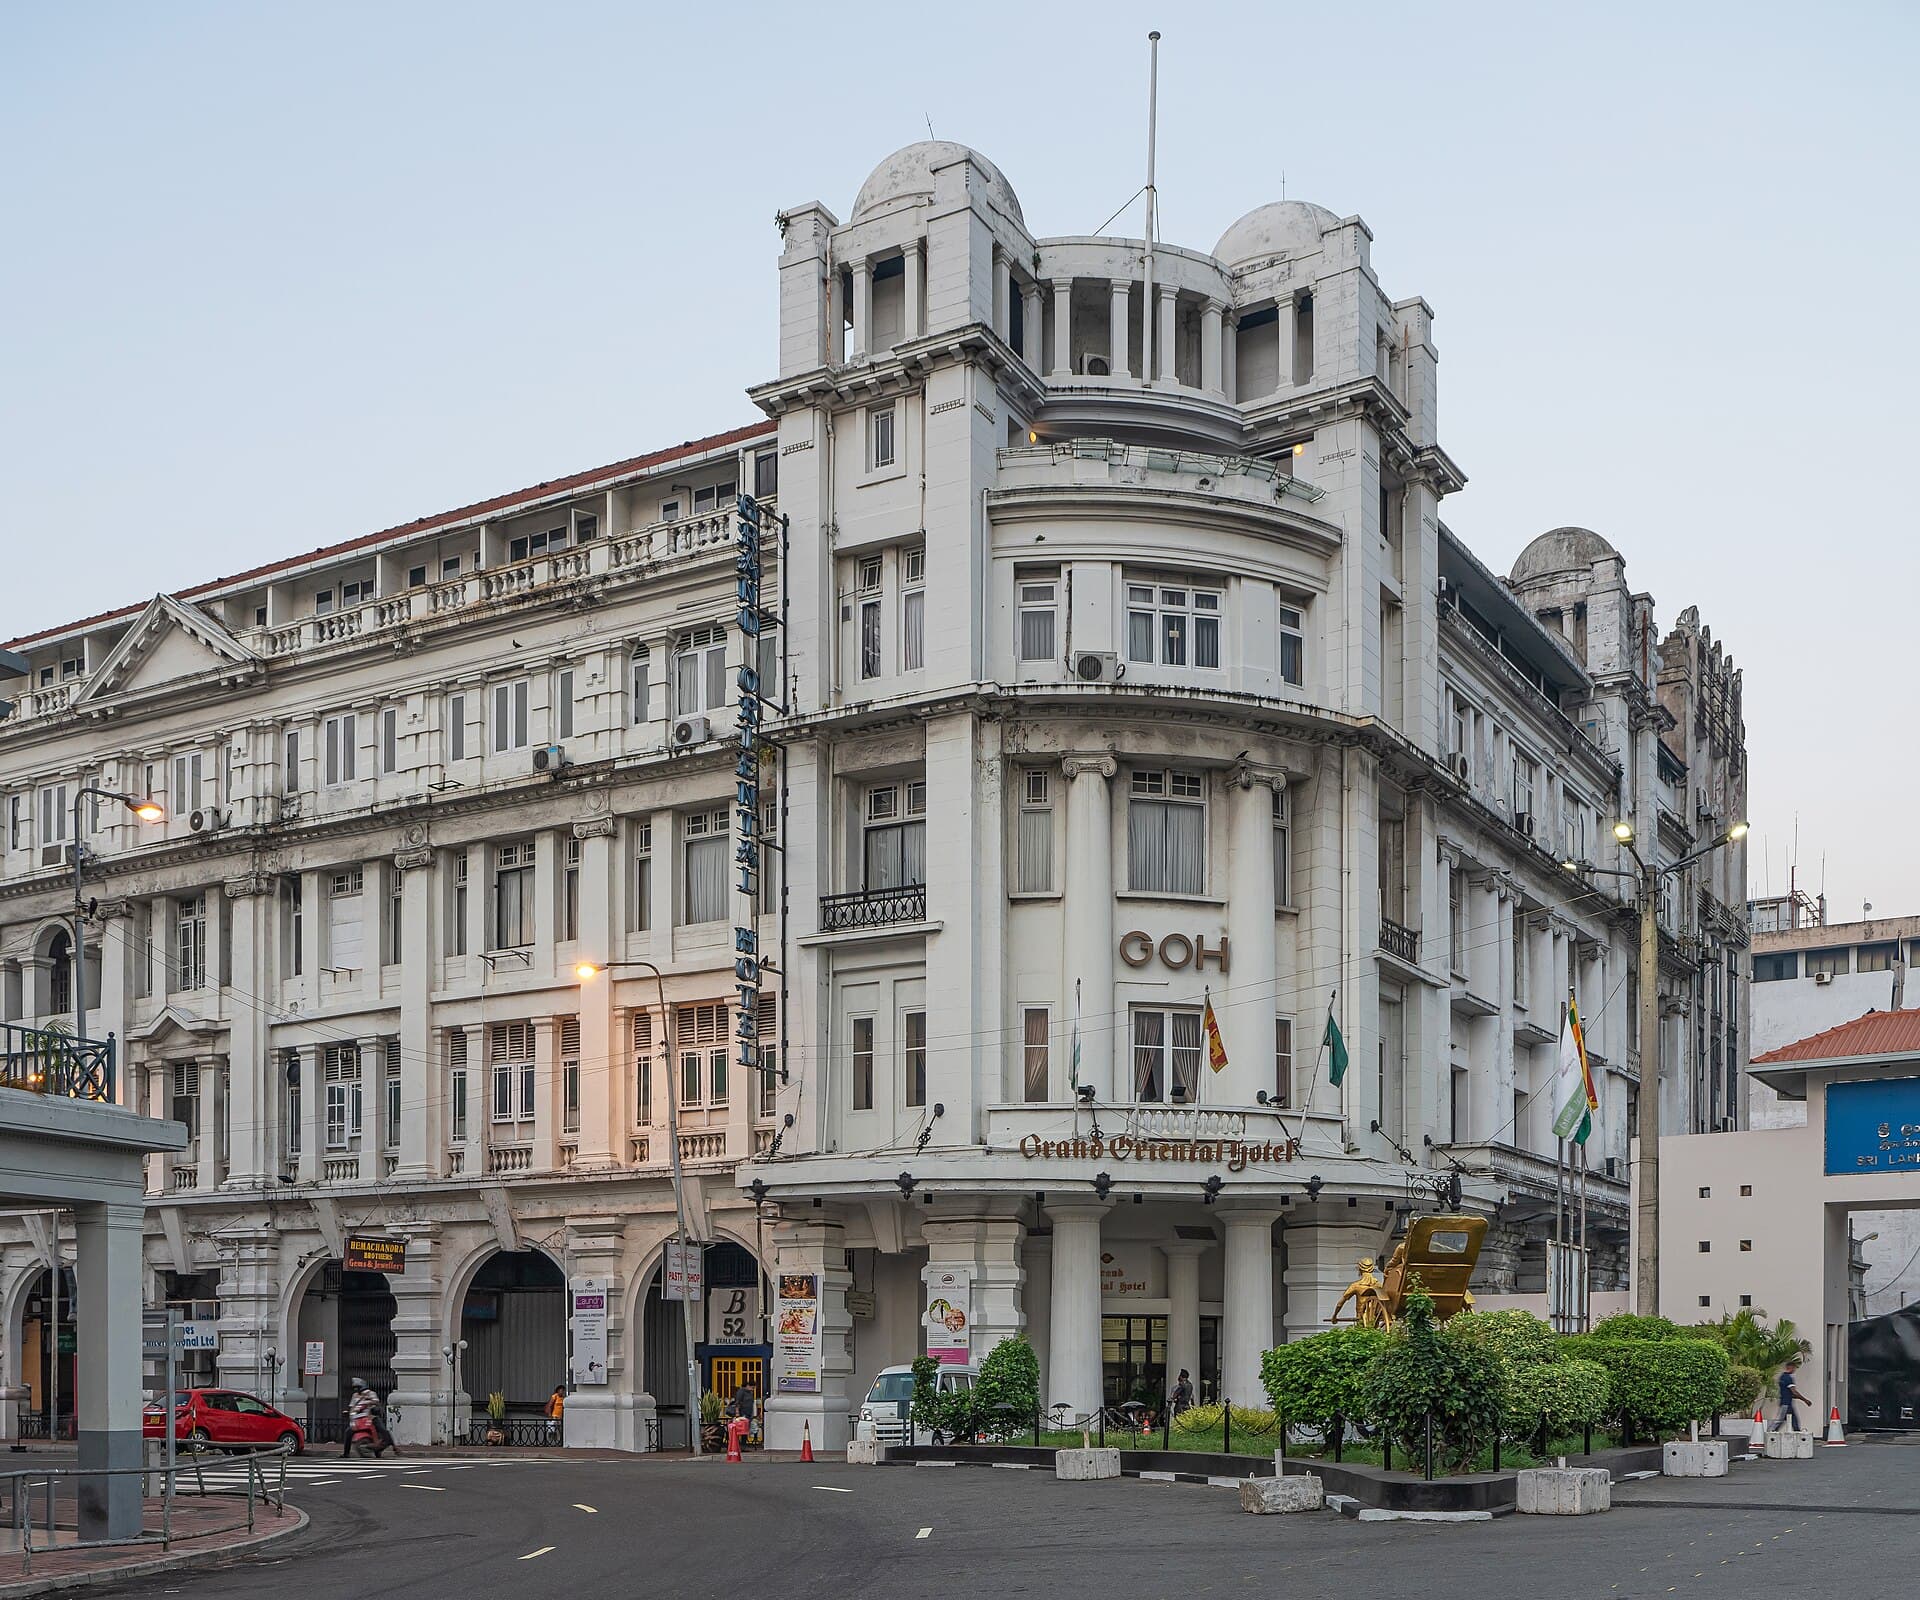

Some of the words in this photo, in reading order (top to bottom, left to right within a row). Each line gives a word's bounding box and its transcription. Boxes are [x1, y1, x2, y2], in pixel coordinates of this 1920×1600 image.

[737, 493, 760, 637] GRAND
[736, 666, 760, 896] ORIENTAL
[1120, 931, 1229, 972] GOH
[735, 926, 757, 1067] HOTEL
[1019, 1133, 1103, 1160] Grand
[1110, 1134, 1223, 1162] Oriental
[1228, 1137, 1296, 1172] Hotel
[1857, 1155, 1878, 1166] SRI
[350, 1241, 404, 1253] HEMACHANDRA
[363, 1252, 393, 1260] BROTHERS
[349, 1258, 366, 1268] Gems
[367, 1260, 373, 1268] &
[374, 1260, 404, 1271] Jewellery
[1119, 1281, 1146, 1294] Hotel
[722, 1290, 746, 1314] B
[723, 1318, 745, 1337] 52
[200, 1335, 215, 1347] Ltd
